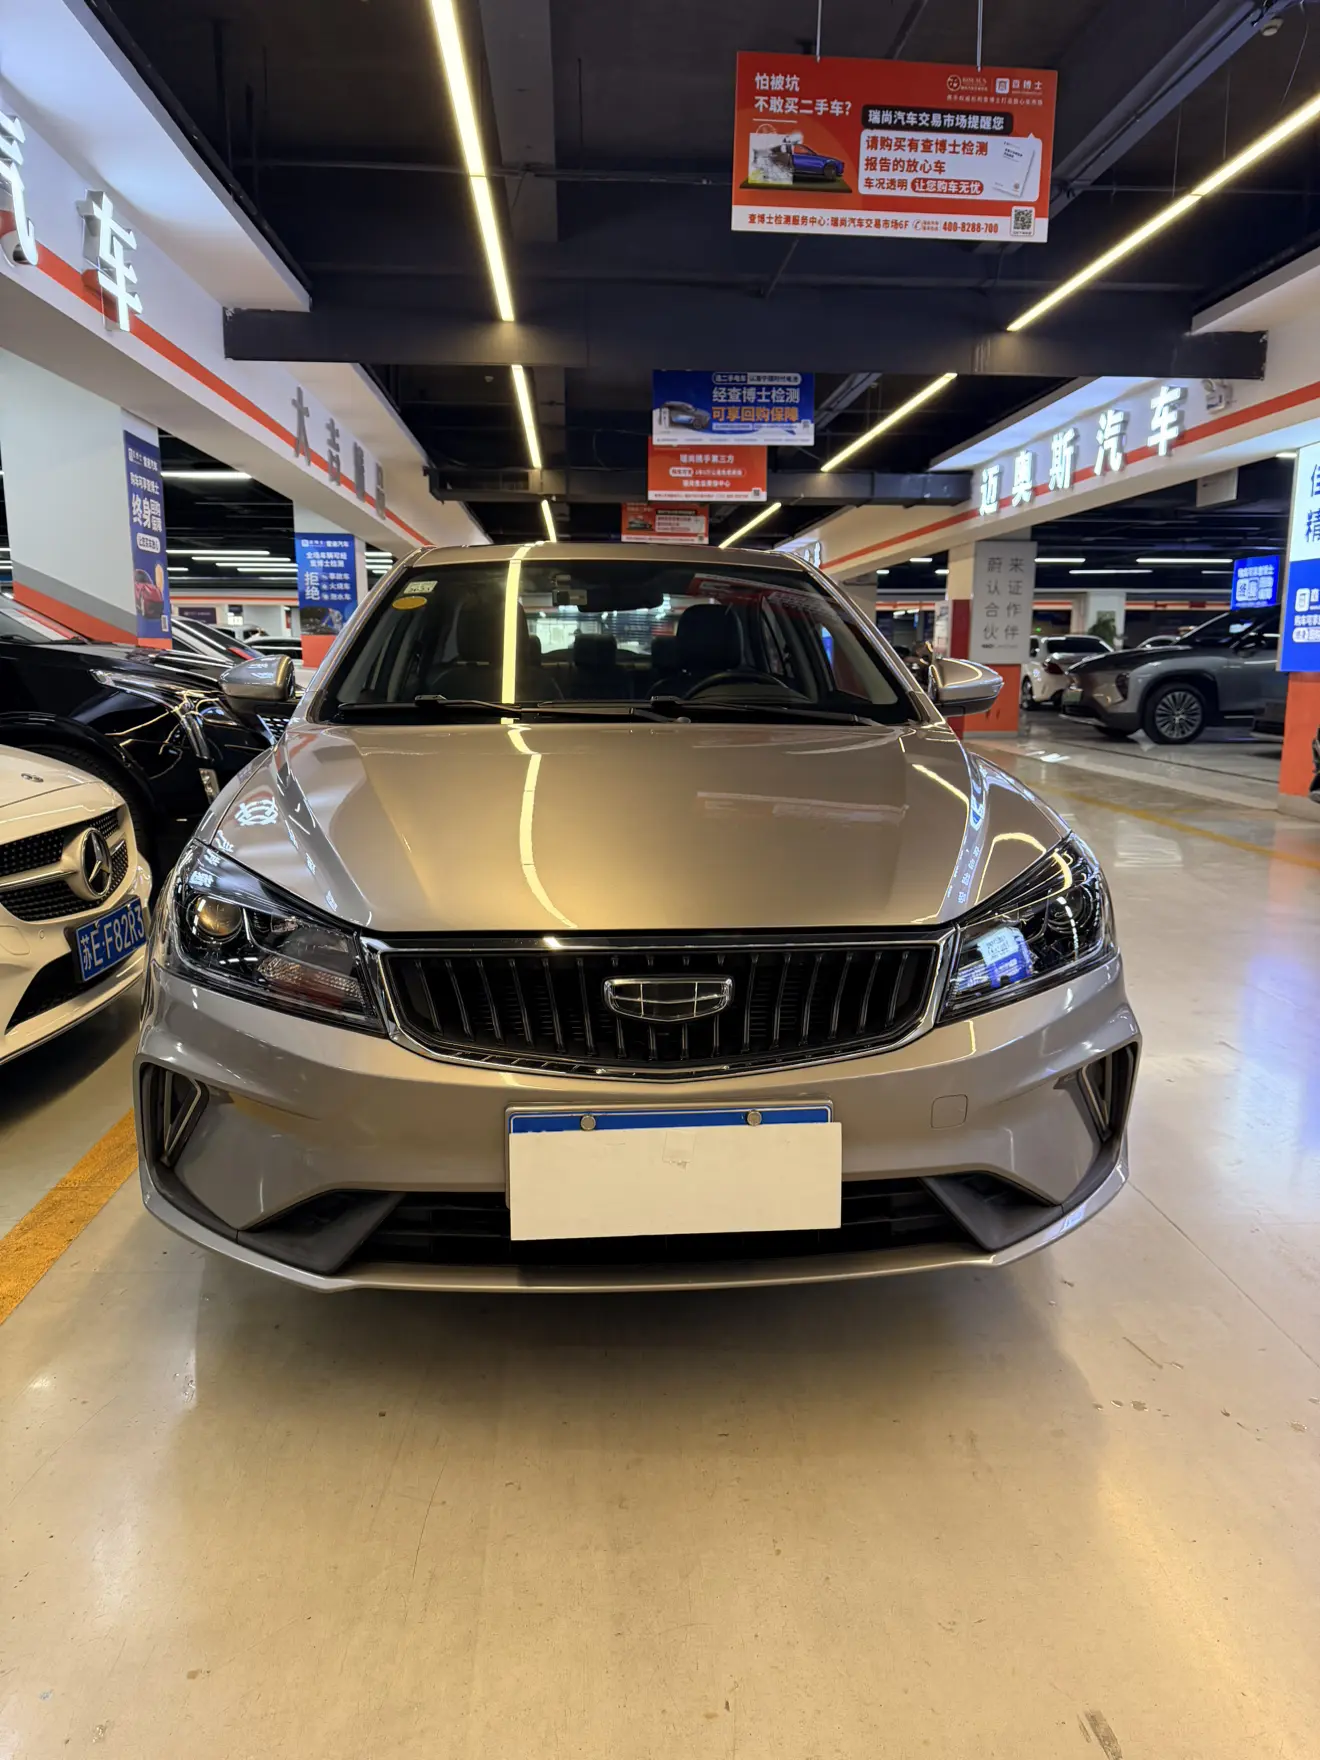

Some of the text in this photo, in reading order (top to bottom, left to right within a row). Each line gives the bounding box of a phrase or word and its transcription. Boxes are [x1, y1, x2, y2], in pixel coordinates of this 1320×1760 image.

[755, 72, 800, 92] 怕被坑
[868, 109, 1005, 131] 瑞尚汽车交易市场提醒您
[866, 135, 989, 157] 请购买有查博士检测
[864, 156, 946, 175] 报告的放心车
[864, 177, 982, 194] 车况透明 让您购车无忧
[942, 221, 999, 234] 400-8288-700
[712, 386, 800, 403] 经查博士检测
[712, 406, 799, 422] 可享回购保障
[979, 385, 1184, 517] 迈奥斯汽车
[987, 556, 1024, 573] 蔚来
[304, 571, 320, 600] 拒绝
[986, 580, 1023, 596] 认证
[984, 602, 1022, 618] 合作
[983, 623, 1020, 640] 伙伴
